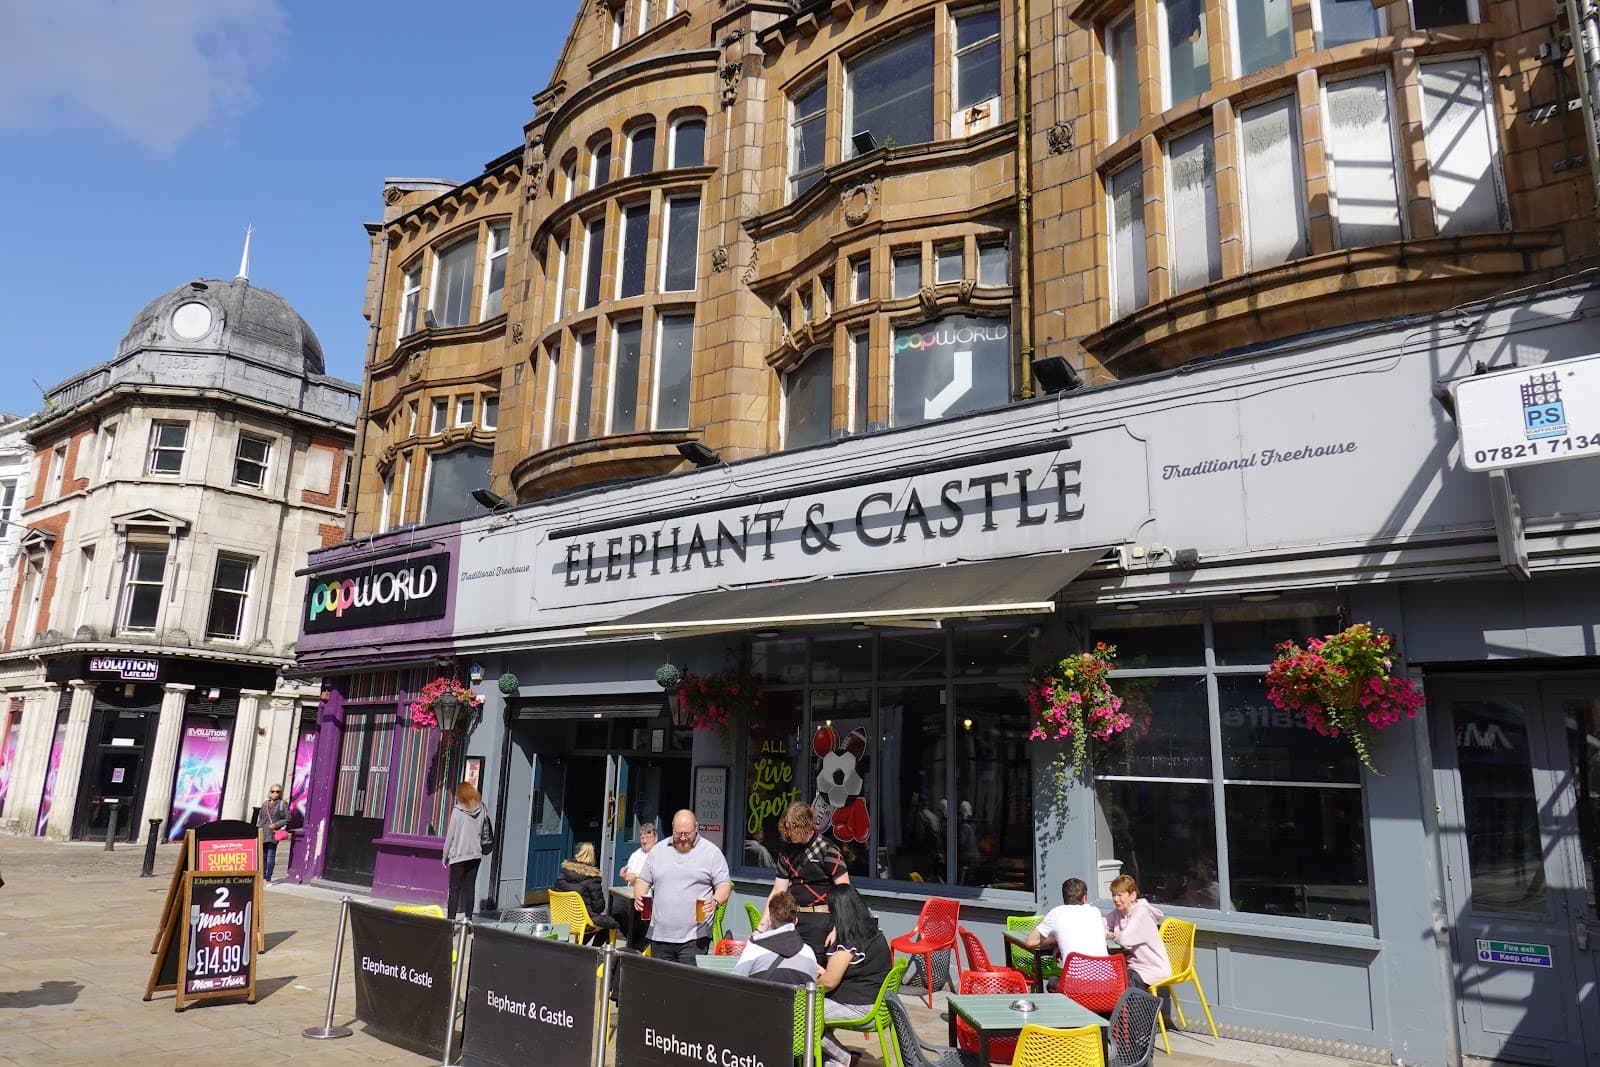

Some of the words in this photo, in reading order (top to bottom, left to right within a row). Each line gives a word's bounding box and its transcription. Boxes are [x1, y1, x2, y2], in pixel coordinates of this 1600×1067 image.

[1527, 407, 1561, 427] P.S
[1162, 453, 1257, 480] Traditional
[1260, 441, 1358, 467] Freehouse
[1474, 442, 1538, 463] 07821
[564, 509, 784, 587] ELEPHANT
[800, 502, 841, 555] &
[855, 460, 1086, 547] CASTLE
[461, 569, 496, 582] Traditional
[496, 564, 531, 578] Freehouse
[91, 659, 157, 671] EVOLUTION
[124, 670, 140, 678] LATE
[141, 671, 155, 679] BAR
[186, 727, 227, 737] EVOLUTION
[761, 740, 787, 753] ALL
[752, 758, 793, 791] Live
[748, 786, 801, 834] Sport
[207, 852, 248, 866] SUMMER
[213, 886, 231, 909] 2
[197, 909, 244, 932] Mains
[209, 930, 233, 943] FOR
[1499, 953, 1520, 963] Keep
[1521, 955, 1542, 964] clear
[1503, 943, 1519, 952] Fire
[1520, 945, 1536, 954] exit
[195, 944, 241, 976] £14.99
[361, 956, 399, 979] Elephant
[400, 966, 408, 981] &
[409, 968, 434, 988] Castle
[487, 990, 526, 1017] Elephant
[528, 1002, 537, 1020] &
[539, 1005, 574, 1028] Castle
[645, 1027, 703, 1060] Elephant
[706, 1043, 718, 1065] &
